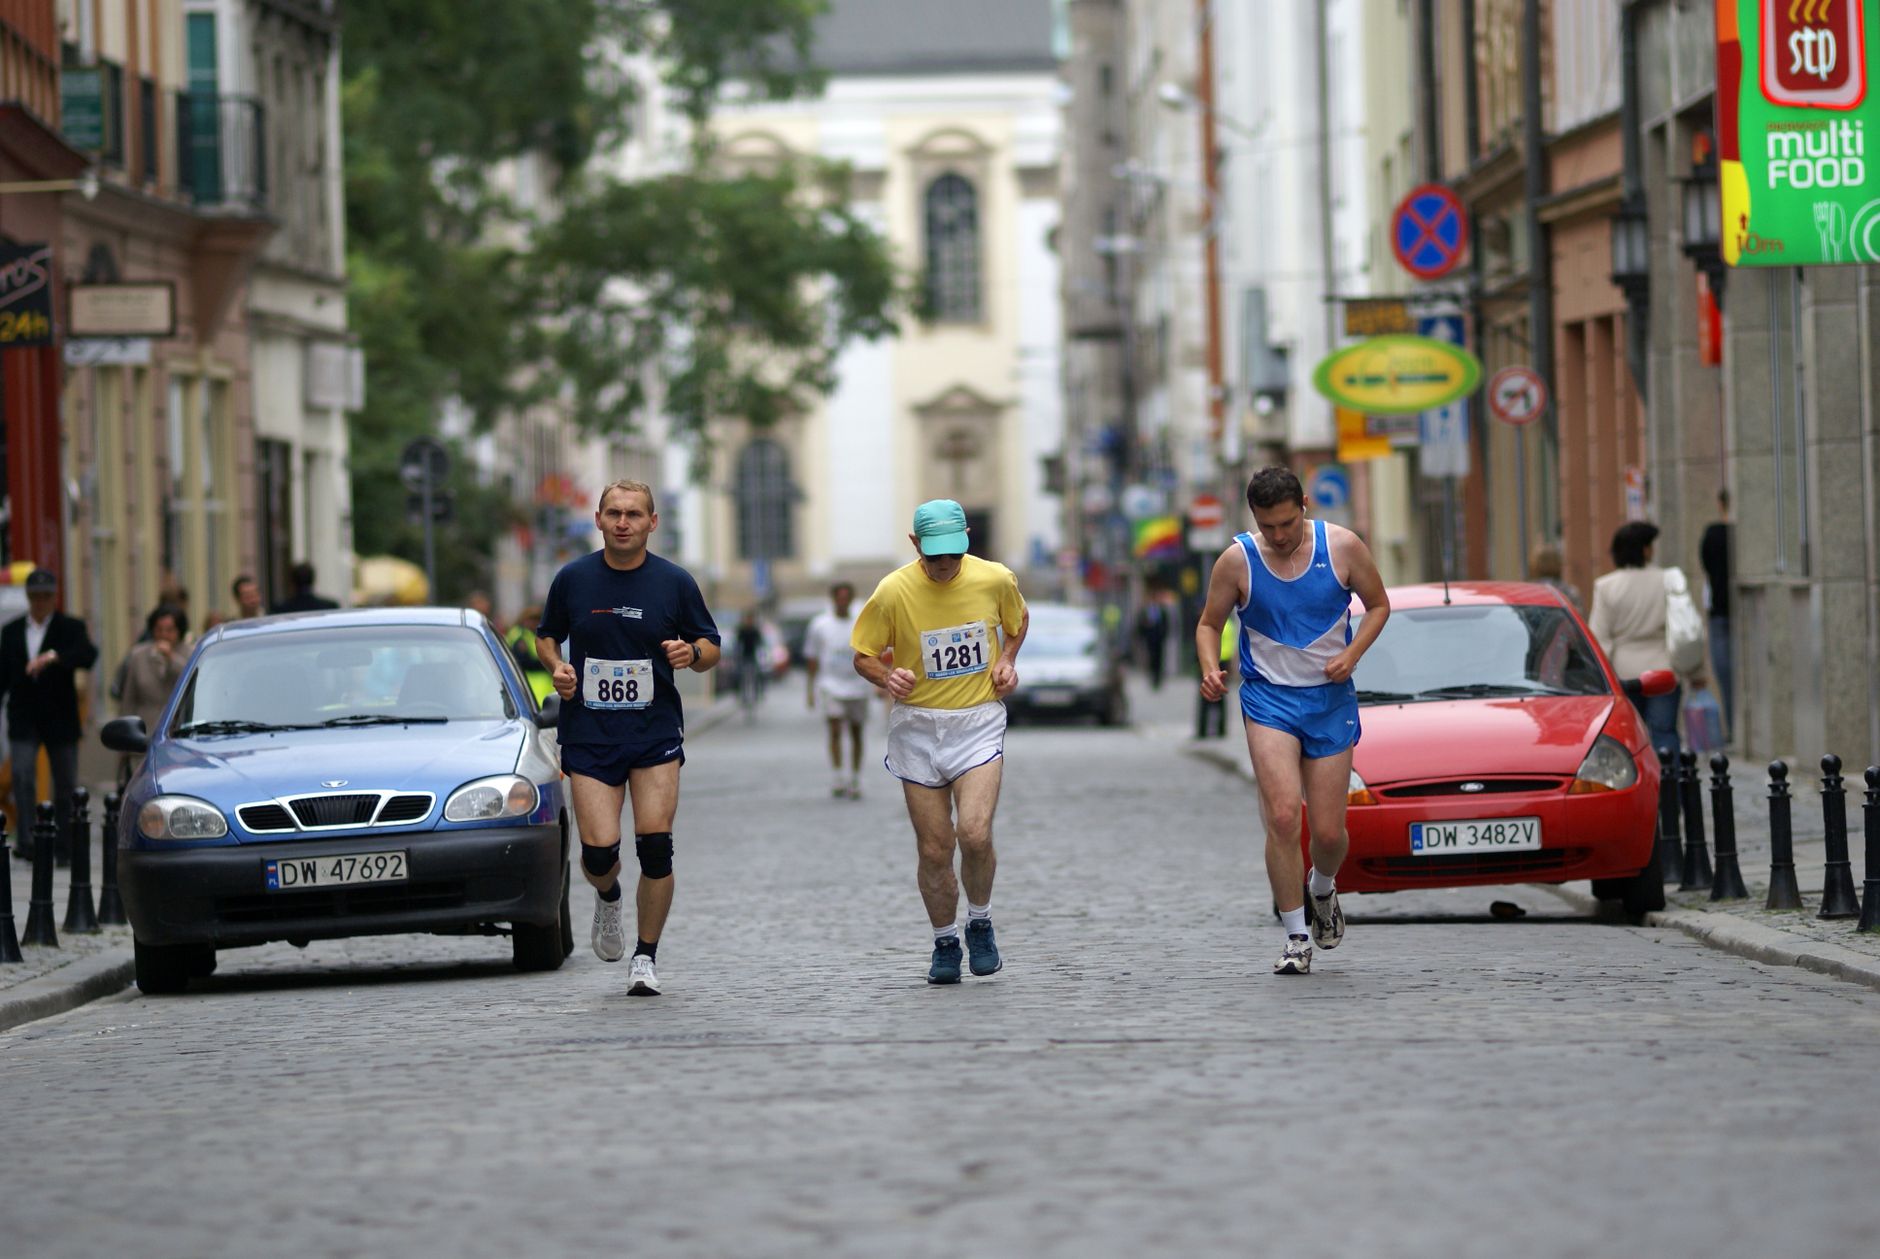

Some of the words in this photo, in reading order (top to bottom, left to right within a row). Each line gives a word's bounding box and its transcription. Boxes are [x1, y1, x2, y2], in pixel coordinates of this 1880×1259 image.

[1788, 26, 1836, 81] stp
[1766, 119, 1864, 159] multi
[1768, 157, 1865, 189] FOOD
[932, 641, 982, 671] 1281
[598, 679, 639, 702] 868
[1426, 826, 1457, 848] DW
[1467, 822, 1534, 845] 3482V
[281, 861, 317, 886] DW
[330, 855, 403, 881] 47692
